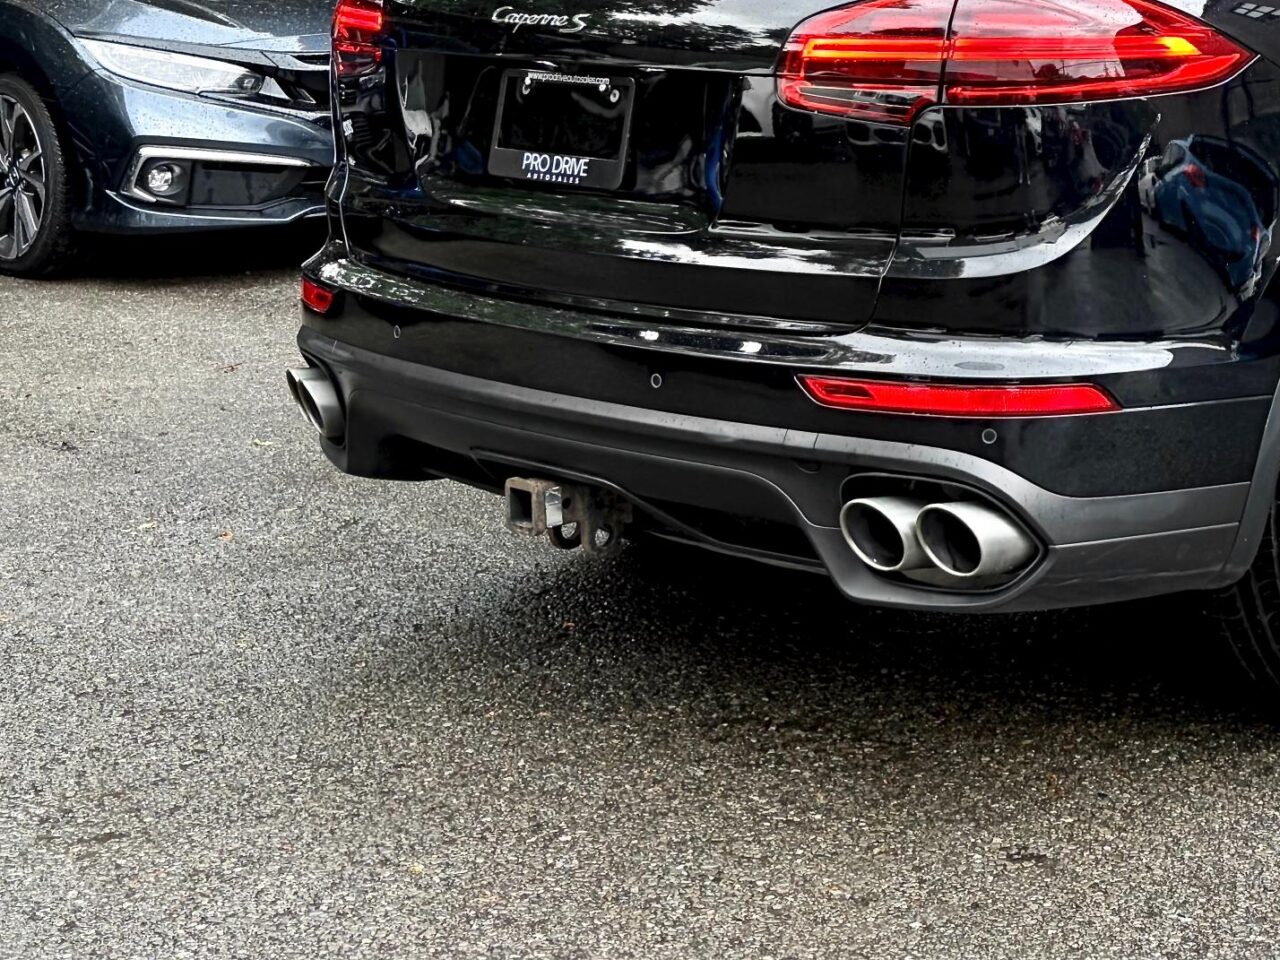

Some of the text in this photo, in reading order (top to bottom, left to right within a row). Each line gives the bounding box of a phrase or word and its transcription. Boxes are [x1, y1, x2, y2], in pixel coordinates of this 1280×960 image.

[491, 6, 591, 33] Cayenne S
[527, 72, 610, 85] www.prodriveautosales.com
[522, 152, 589, 177] PRO DRIVE
[526, 172, 580, 184] AUTOSALES
